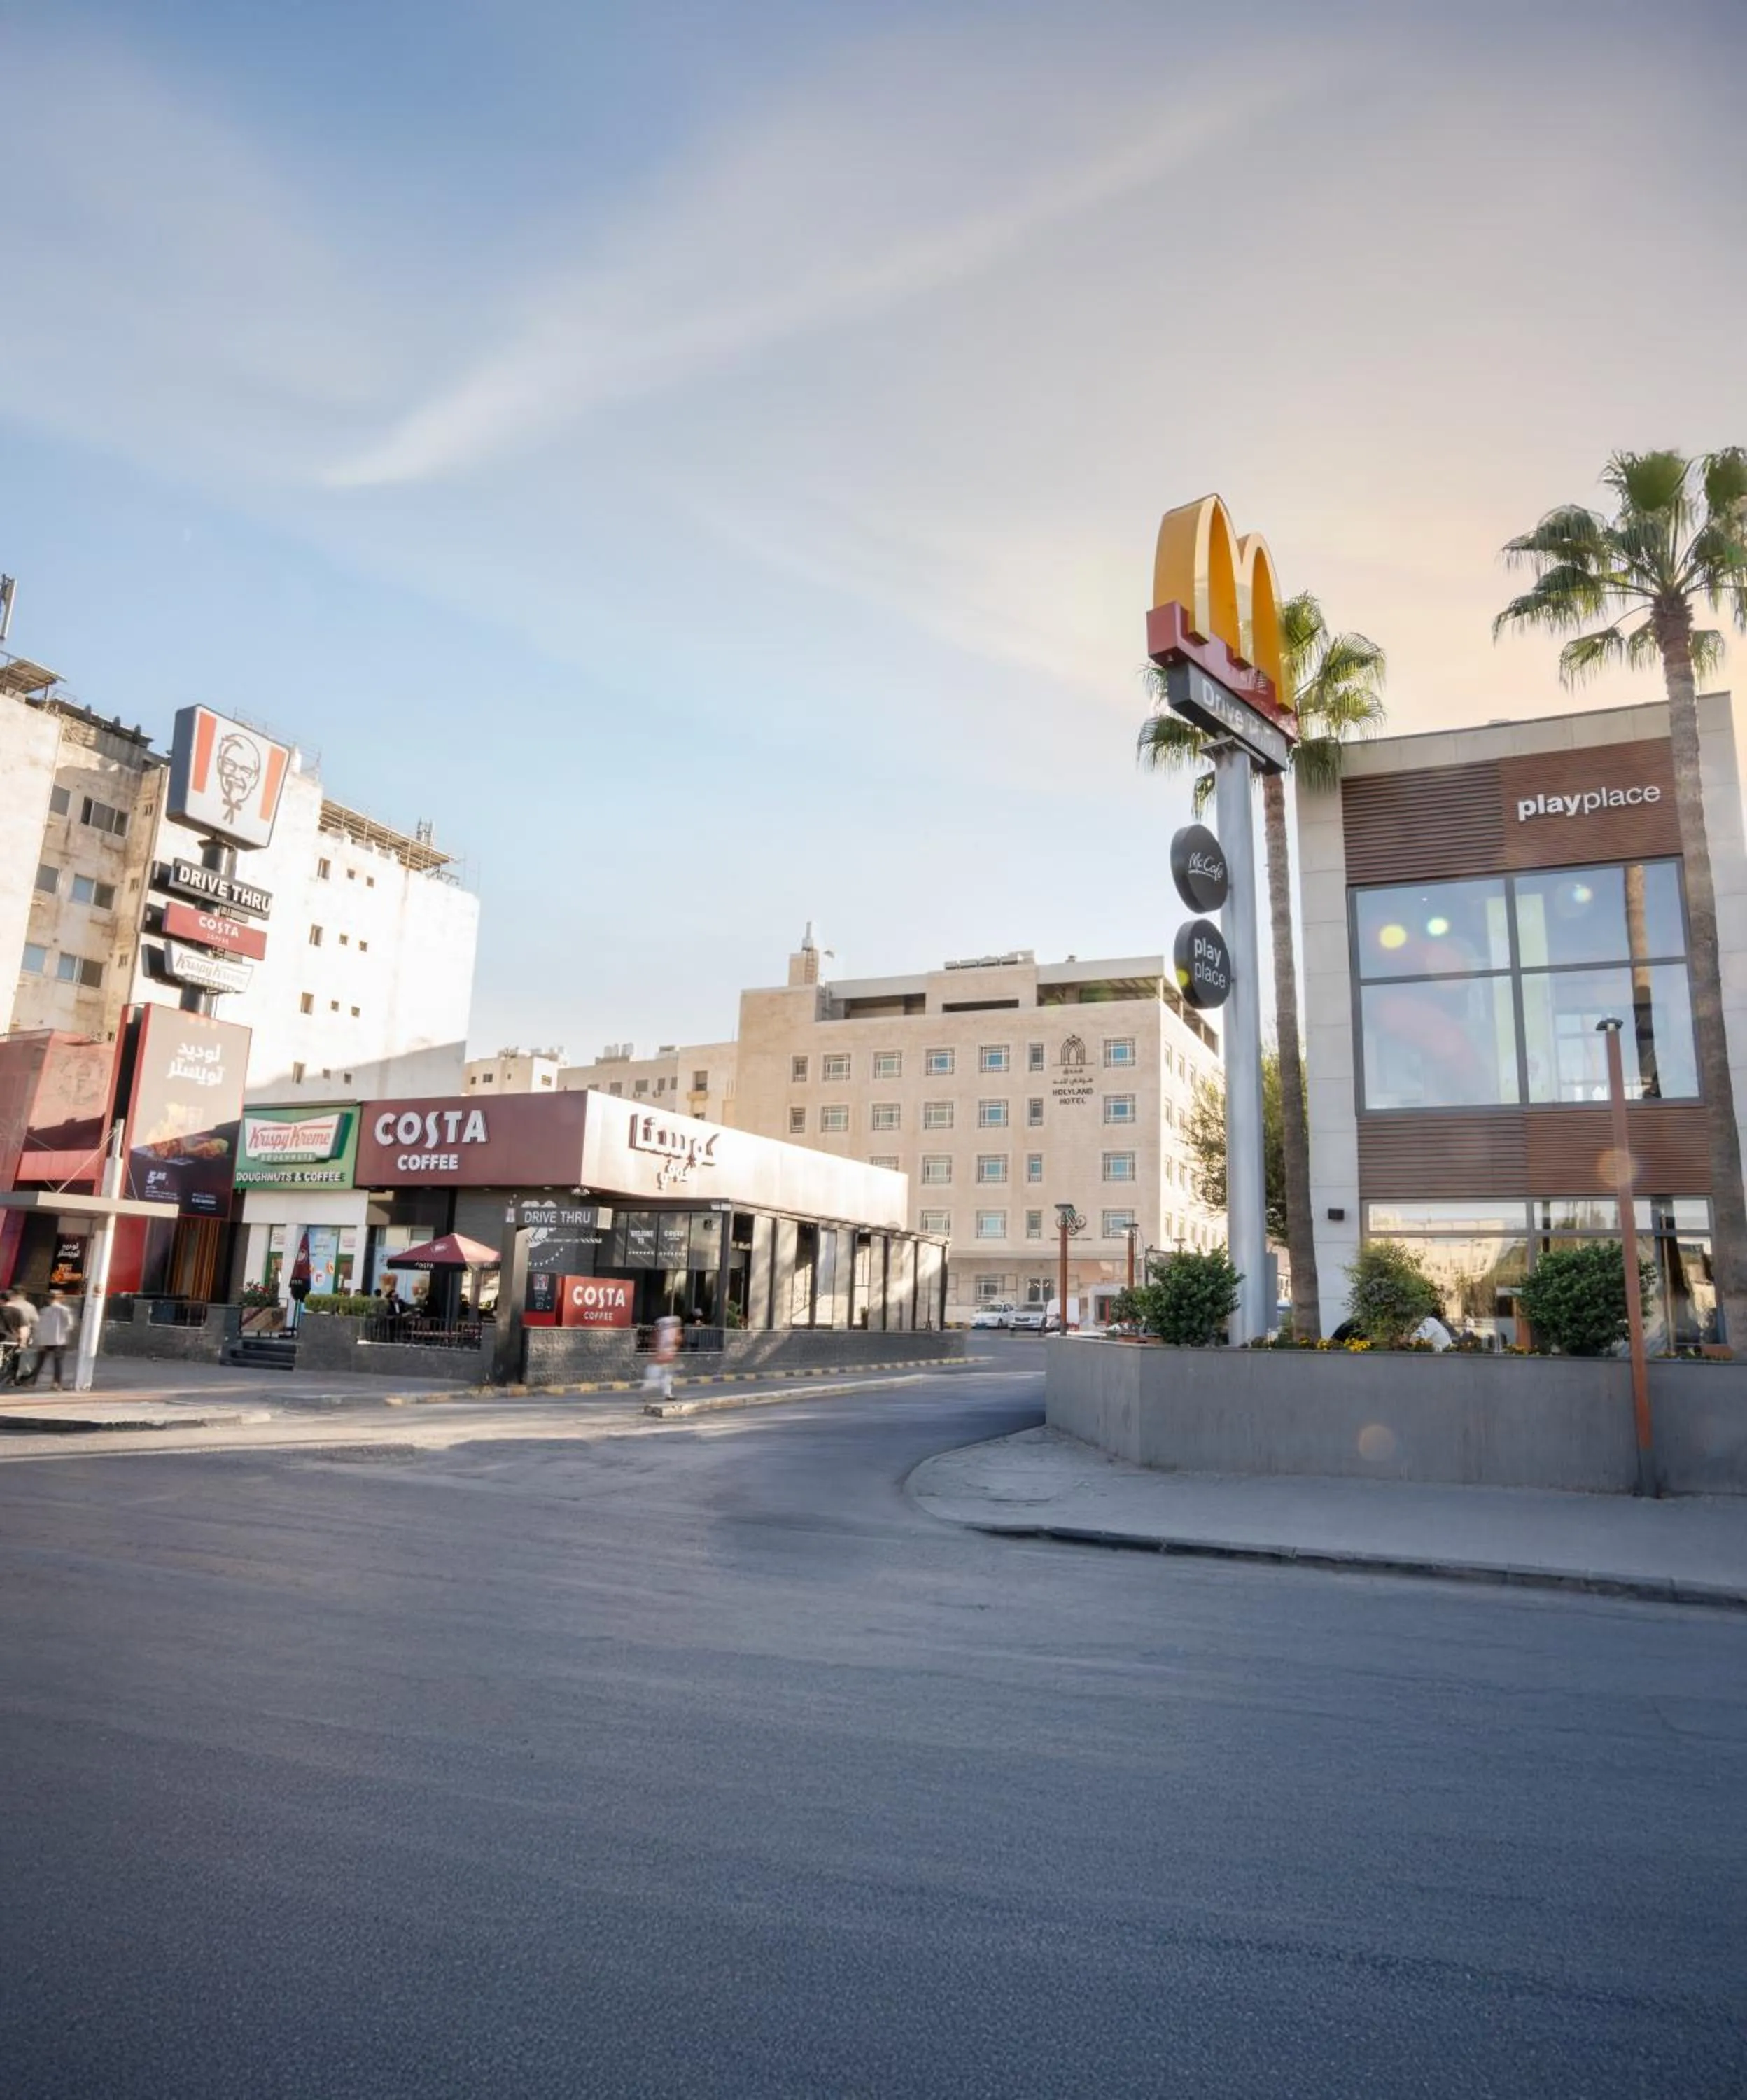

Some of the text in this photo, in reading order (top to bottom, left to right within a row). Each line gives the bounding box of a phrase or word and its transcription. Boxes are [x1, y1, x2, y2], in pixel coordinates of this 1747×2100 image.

[1202, 678, 1244, 726] Drive
[1517, 785, 1661, 822] playplace
[178, 864, 272, 913] DRIVE THRU
[198, 916, 239, 939] COSTA
[1194, 938, 1221, 967] play
[1195, 962, 1226, 988] place
[1059, 1097, 1086, 1105] HOTEL
[248, 1124, 333, 1151] Krispy Kreme
[374, 1109, 487, 1149] COSTA
[397, 1154, 458, 1171] COFFEE
[235, 1171, 342, 1182] DOUGHNUTS & COFFEE
[525, 1210, 591, 1224] DRIVE THRU
[572, 1285, 625, 1308] COSTA
[583, 1310, 613, 1321] COFFEE
